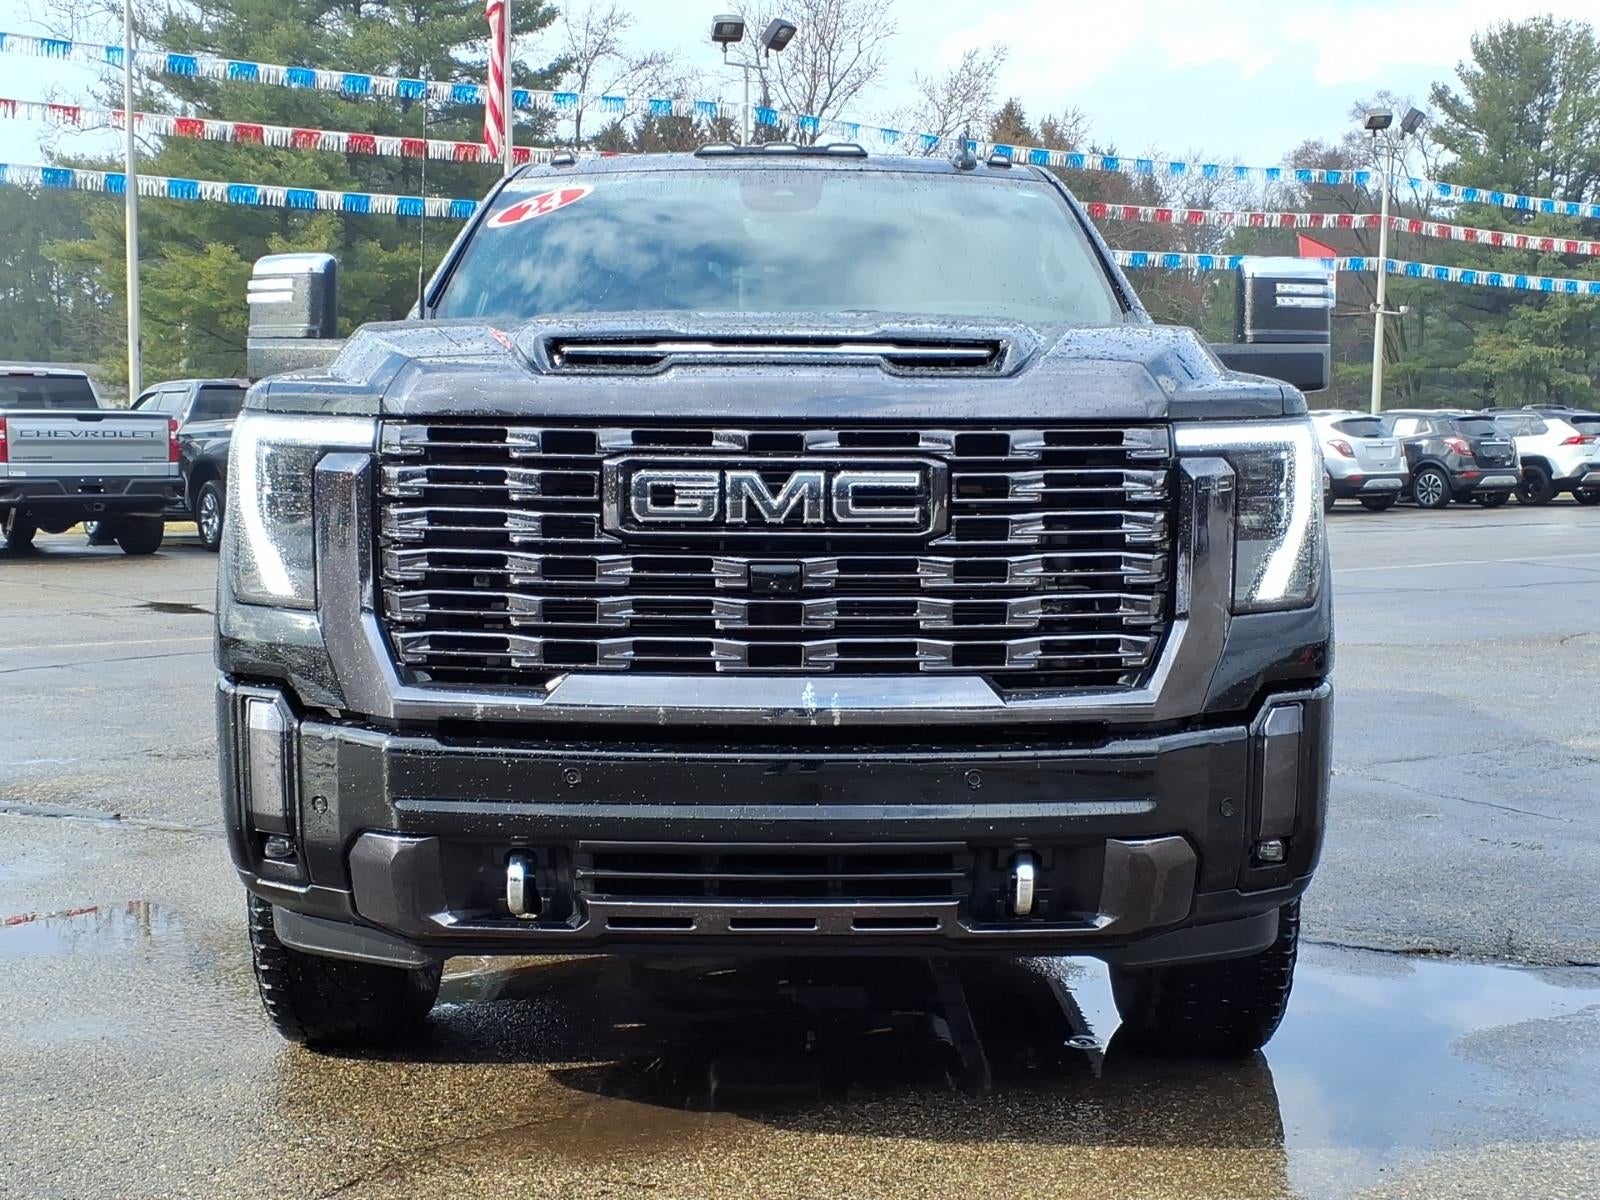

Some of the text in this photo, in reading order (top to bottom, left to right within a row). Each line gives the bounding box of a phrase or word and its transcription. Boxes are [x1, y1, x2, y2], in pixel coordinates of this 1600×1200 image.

[520, 189, 564, 220] 24
[19, 430, 157, 438] CHEVROLET
[630, 469, 921, 524] GMC
